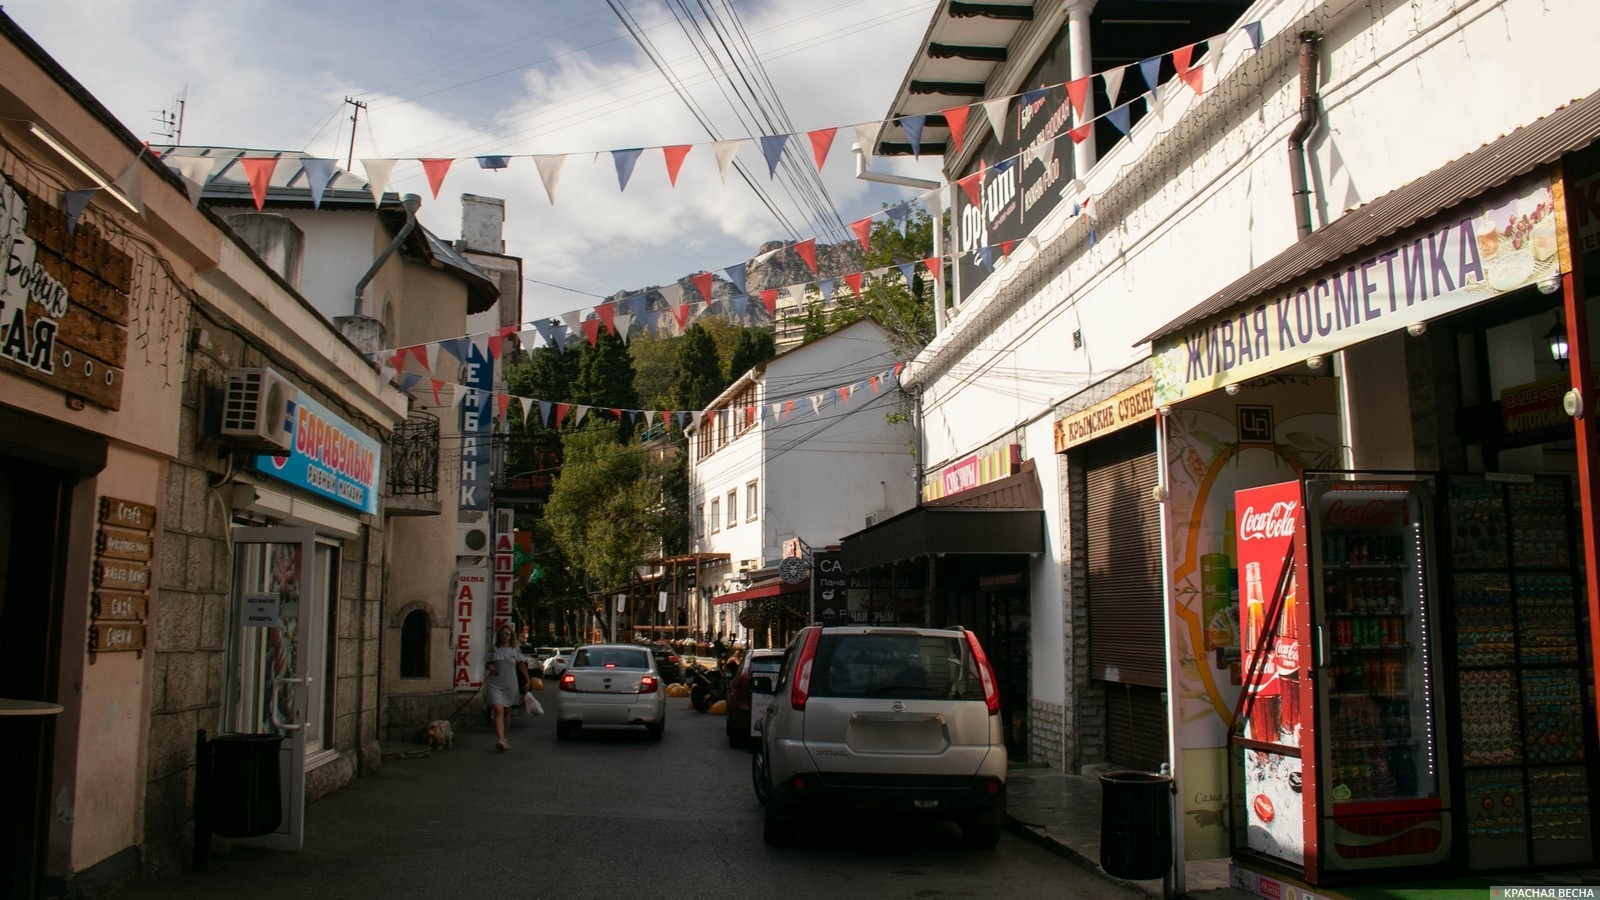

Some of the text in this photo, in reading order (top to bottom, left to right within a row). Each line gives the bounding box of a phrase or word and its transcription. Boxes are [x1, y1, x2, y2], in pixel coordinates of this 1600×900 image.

[1184, 217, 1485, 384] ЖИВАЯ КОСМЕТИКА
[0, 301, 56, 373] АЯ
[1069, 386, 1154, 442] КРЫМСКИЕ СУВЕНИ
[1507, 405, 1566, 433] ФОТОТОВА
[296, 405, 374, 488] БАРАБУЛЬКА
[307, 463, 363, 505] РЫБНЫЙ МАГАЗИН
[946, 462, 976, 495] СУВЕНИРЫ
[118, 502, 141, 524] Craft
[1240, 501, 1297, 541] Coca-Cola
[1326, 499, 1394, 526] Coca-Cola
[494, 534, 512, 632] АПТЕК
[456, 585, 473, 683] АПТЕКА
